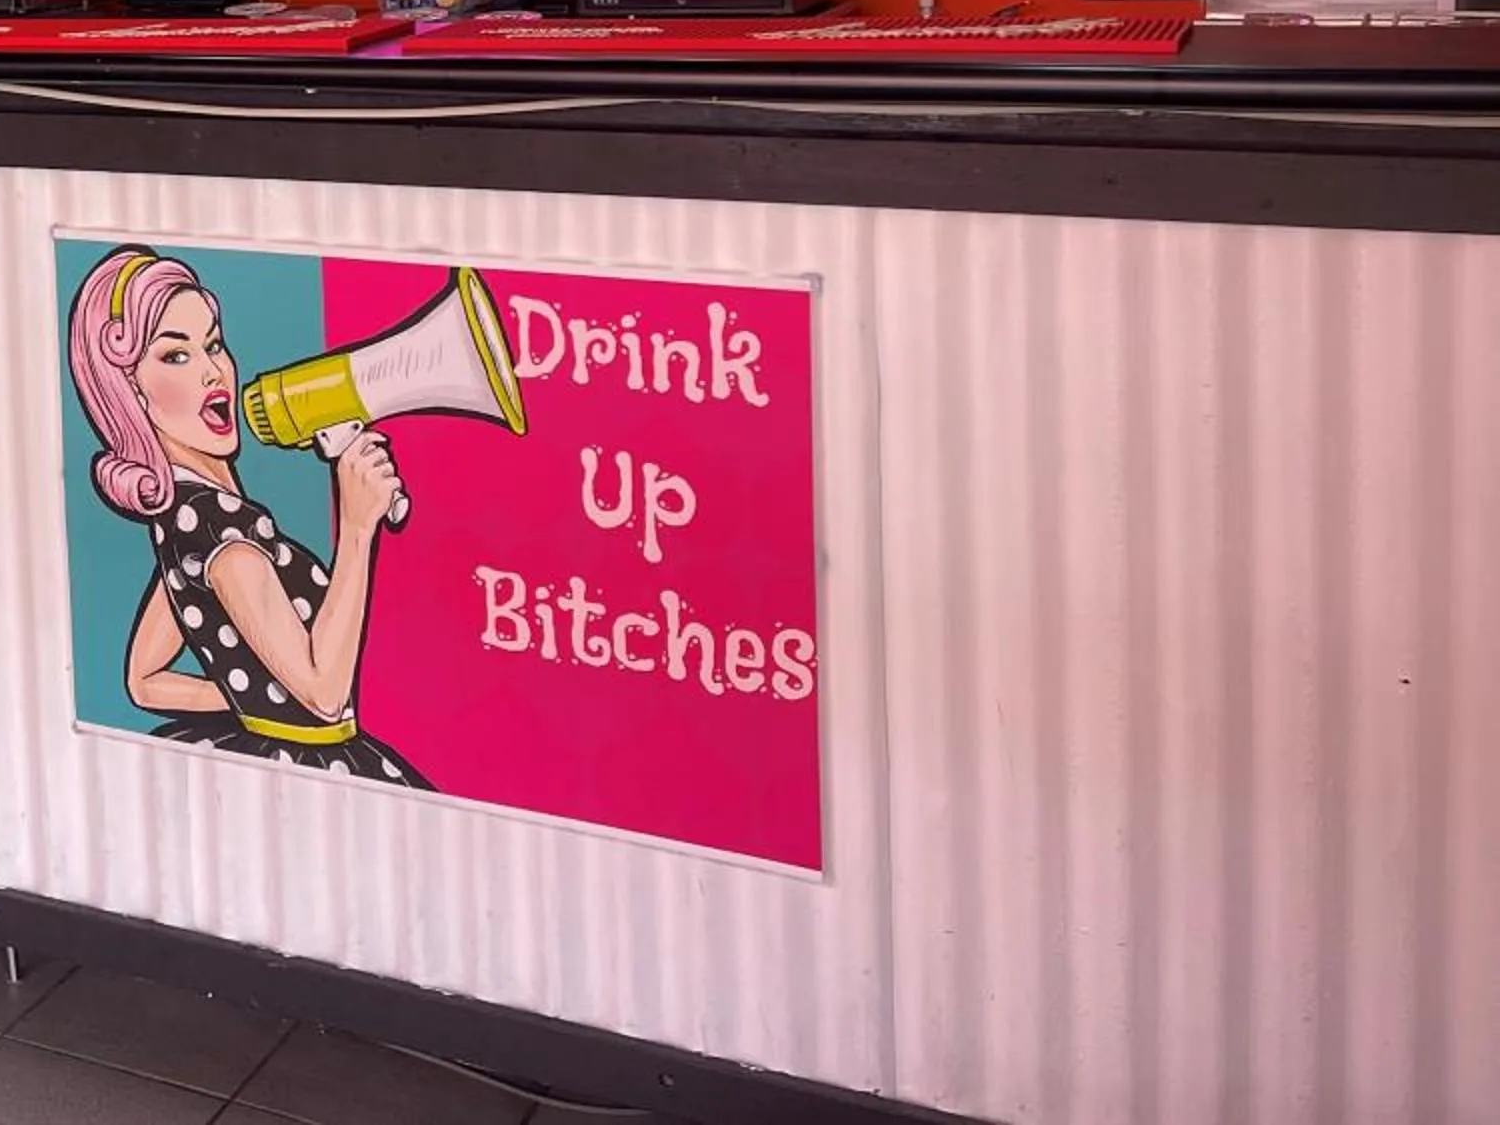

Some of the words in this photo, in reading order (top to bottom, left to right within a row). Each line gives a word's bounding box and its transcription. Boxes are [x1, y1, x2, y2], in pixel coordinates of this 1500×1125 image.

[509, 294, 769, 407] Drink
[579, 446, 697, 563] Up
[472, 565, 818, 700] Bitches
